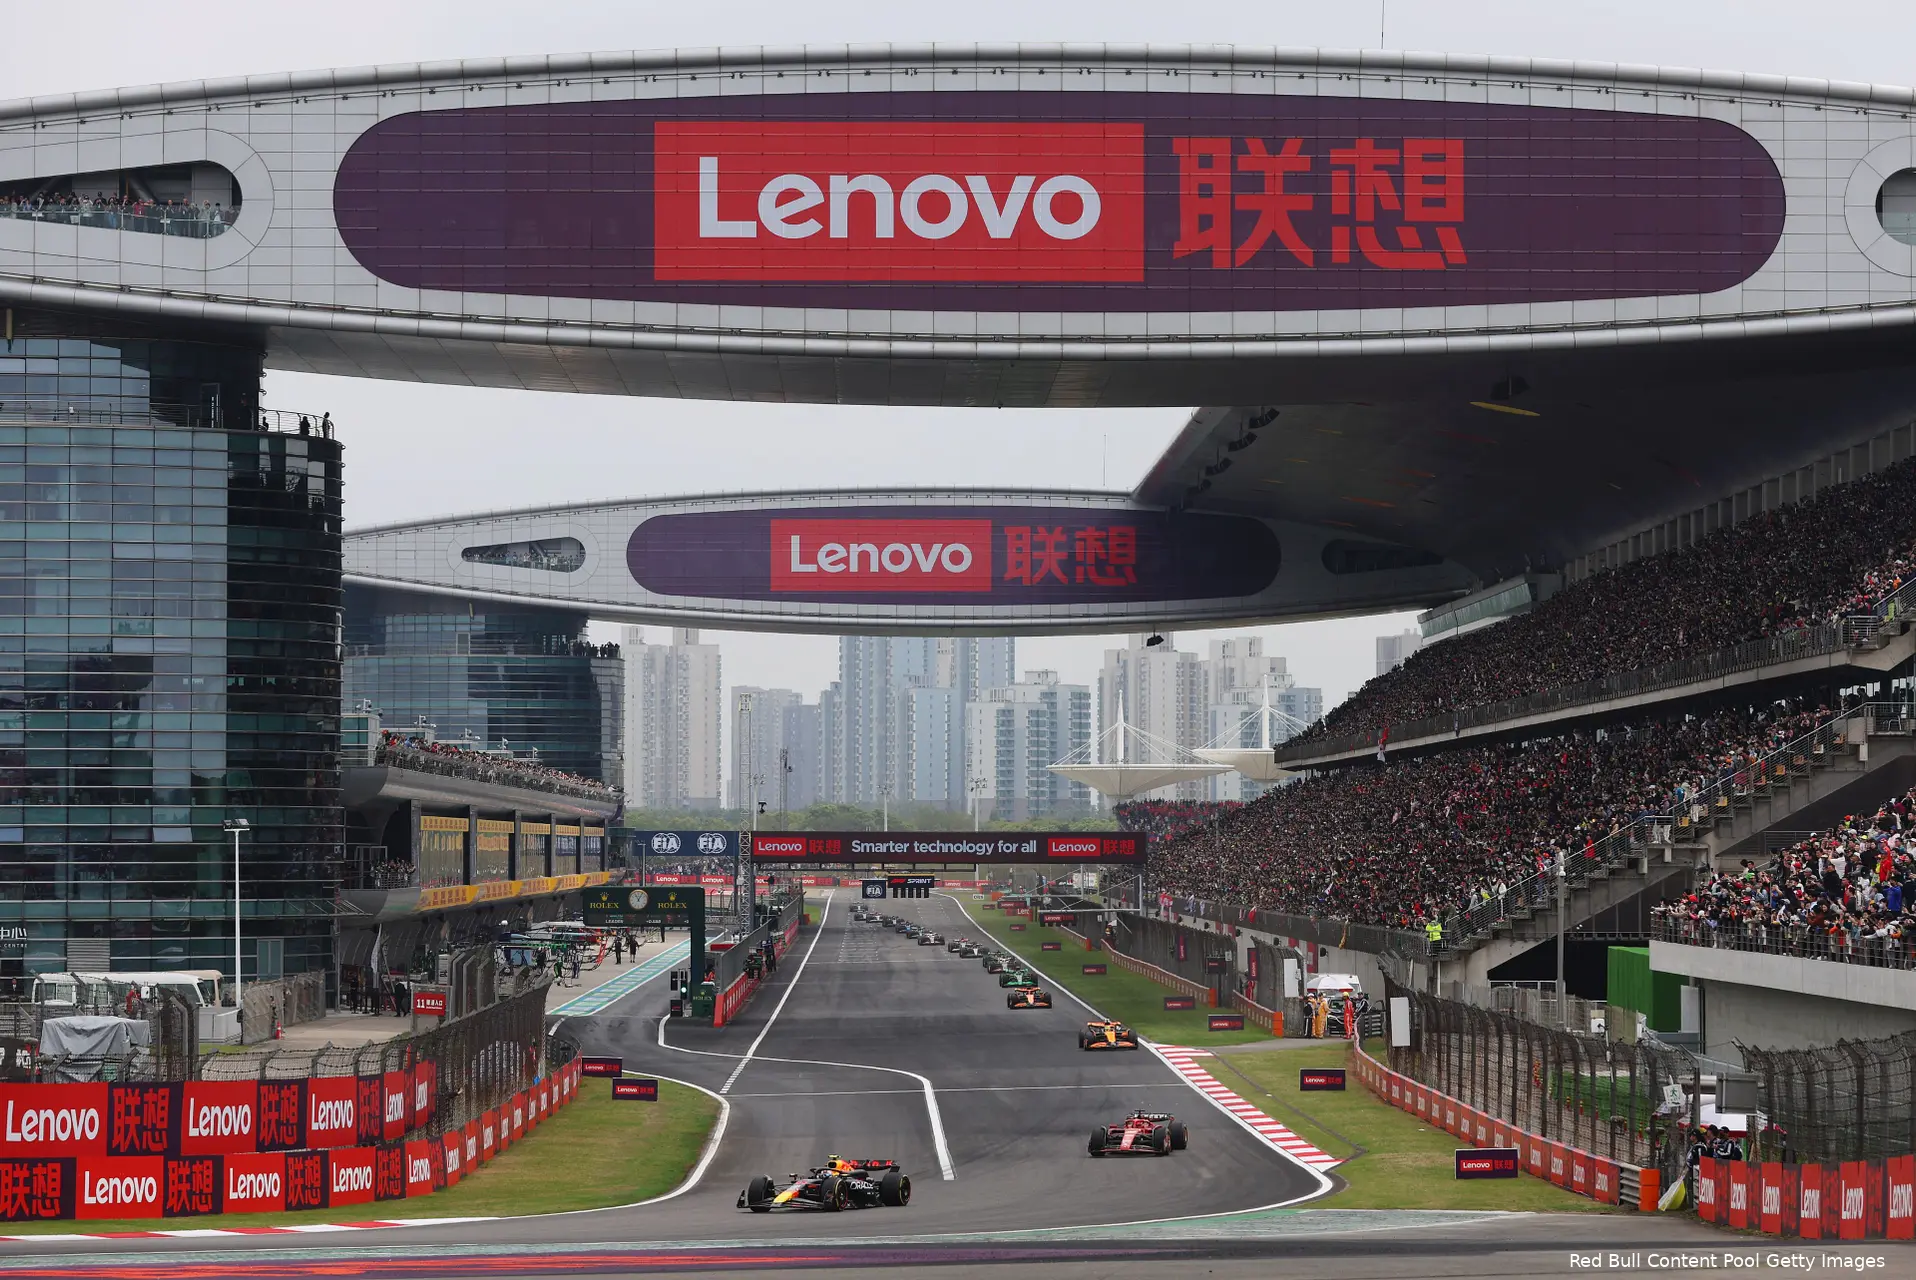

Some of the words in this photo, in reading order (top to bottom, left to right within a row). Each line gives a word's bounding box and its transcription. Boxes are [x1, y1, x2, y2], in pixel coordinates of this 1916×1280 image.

[699, 156, 1101, 241] Lenovo
[1172, 136, 1468, 270] 联想
[791, 535, 972, 573] Lenovo
[1004, 526, 1137, 586] 联想
[758, 840, 802, 851] Lenovo
[809, 839, 841, 855] 联想
[851, 839, 909, 853] Smarter
[914, 839, 994, 855] technology
[998, 839, 1019, 853] for
[1021, 839, 1036, 853] all
[1052, 841, 1096, 852] Lenovo
[1103, 839, 1135, 855] 联想
[416, 999, 425, 1008] 11
[6, 1100, 99, 1142] Lenovo
[112, 1088, 170, 1152] 联想
[189, 1097, 251, 1137] Lenovo
[259, 1084, 299, 1146] 联想
[311, 1093, 354, 1130] Lenovo
[385, 1087, 404, 1123] Lenovo
[1462, 1161, 1491, 1169] Lenovo
[0, 1162, 61, 1218] 联想
[84, 1171, 157, 1205] Lenovo
[166, 1160, 213, 1212] 联想
[229, 1168, 280, 1199] Lenovo
[287, 1155, 321, 1207] 联想
[333, 1161, 372, 1192] Lenovo
[376, 1148, 400, 1198] 联想
[408, 1154, 430, 1183] Lenovo
